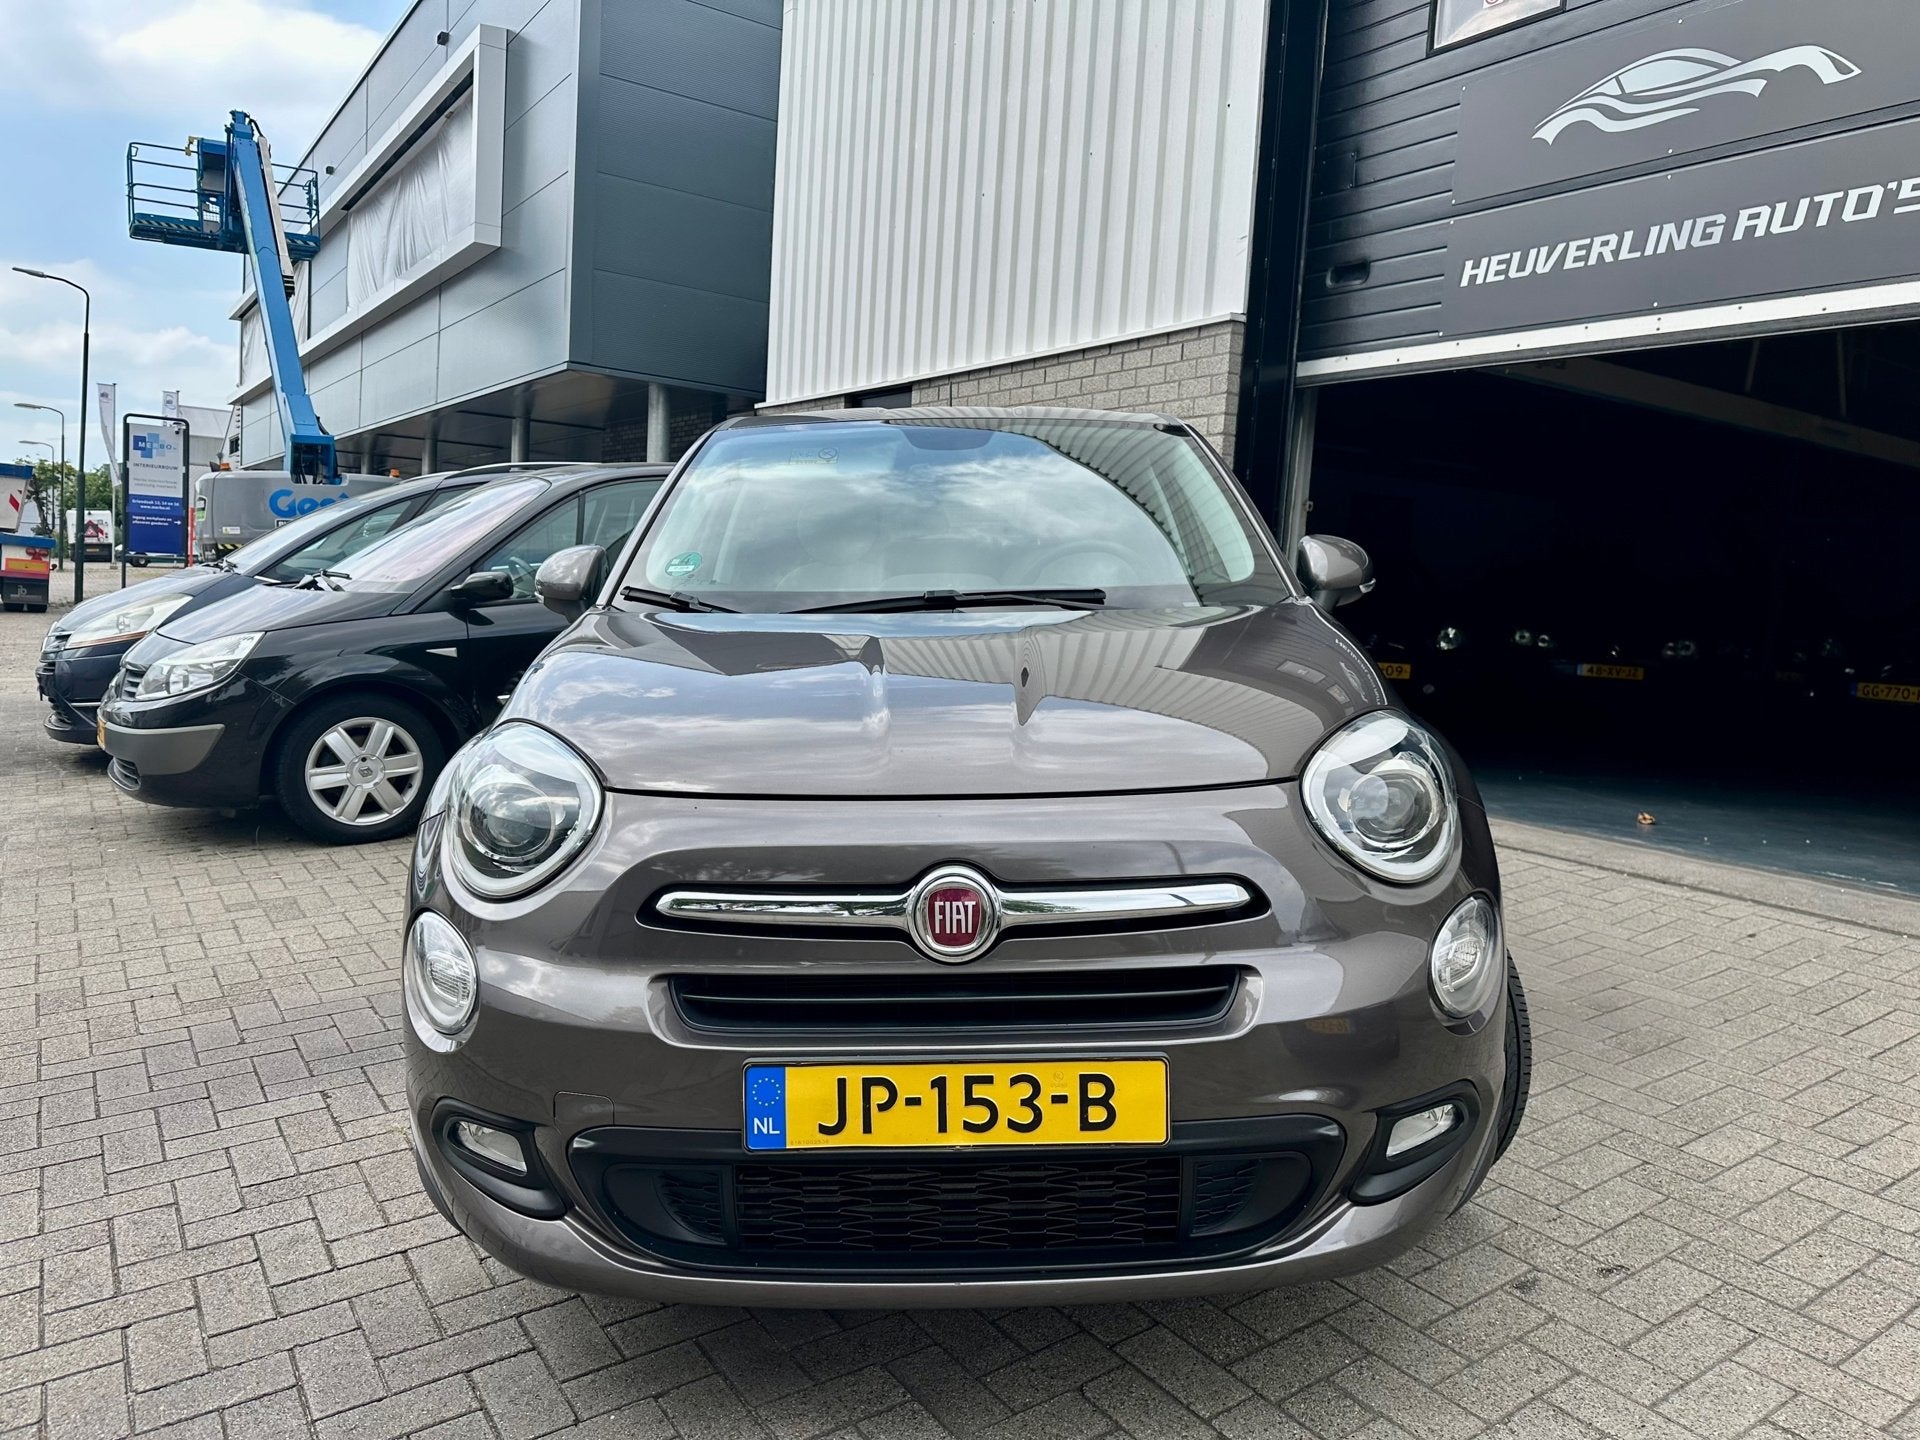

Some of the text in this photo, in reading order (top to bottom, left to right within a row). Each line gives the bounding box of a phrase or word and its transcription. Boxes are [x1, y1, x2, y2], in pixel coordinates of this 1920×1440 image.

[1460, 213, 1727, 288] HEUVERLING
[138, 441, 172, 450] MERBO
[133, 462, 178, 470] INTERIEURBOUW
[934, 901, 977, 934] FIAT
[753, 1072, 1117, 1136] NL JP-153-B
